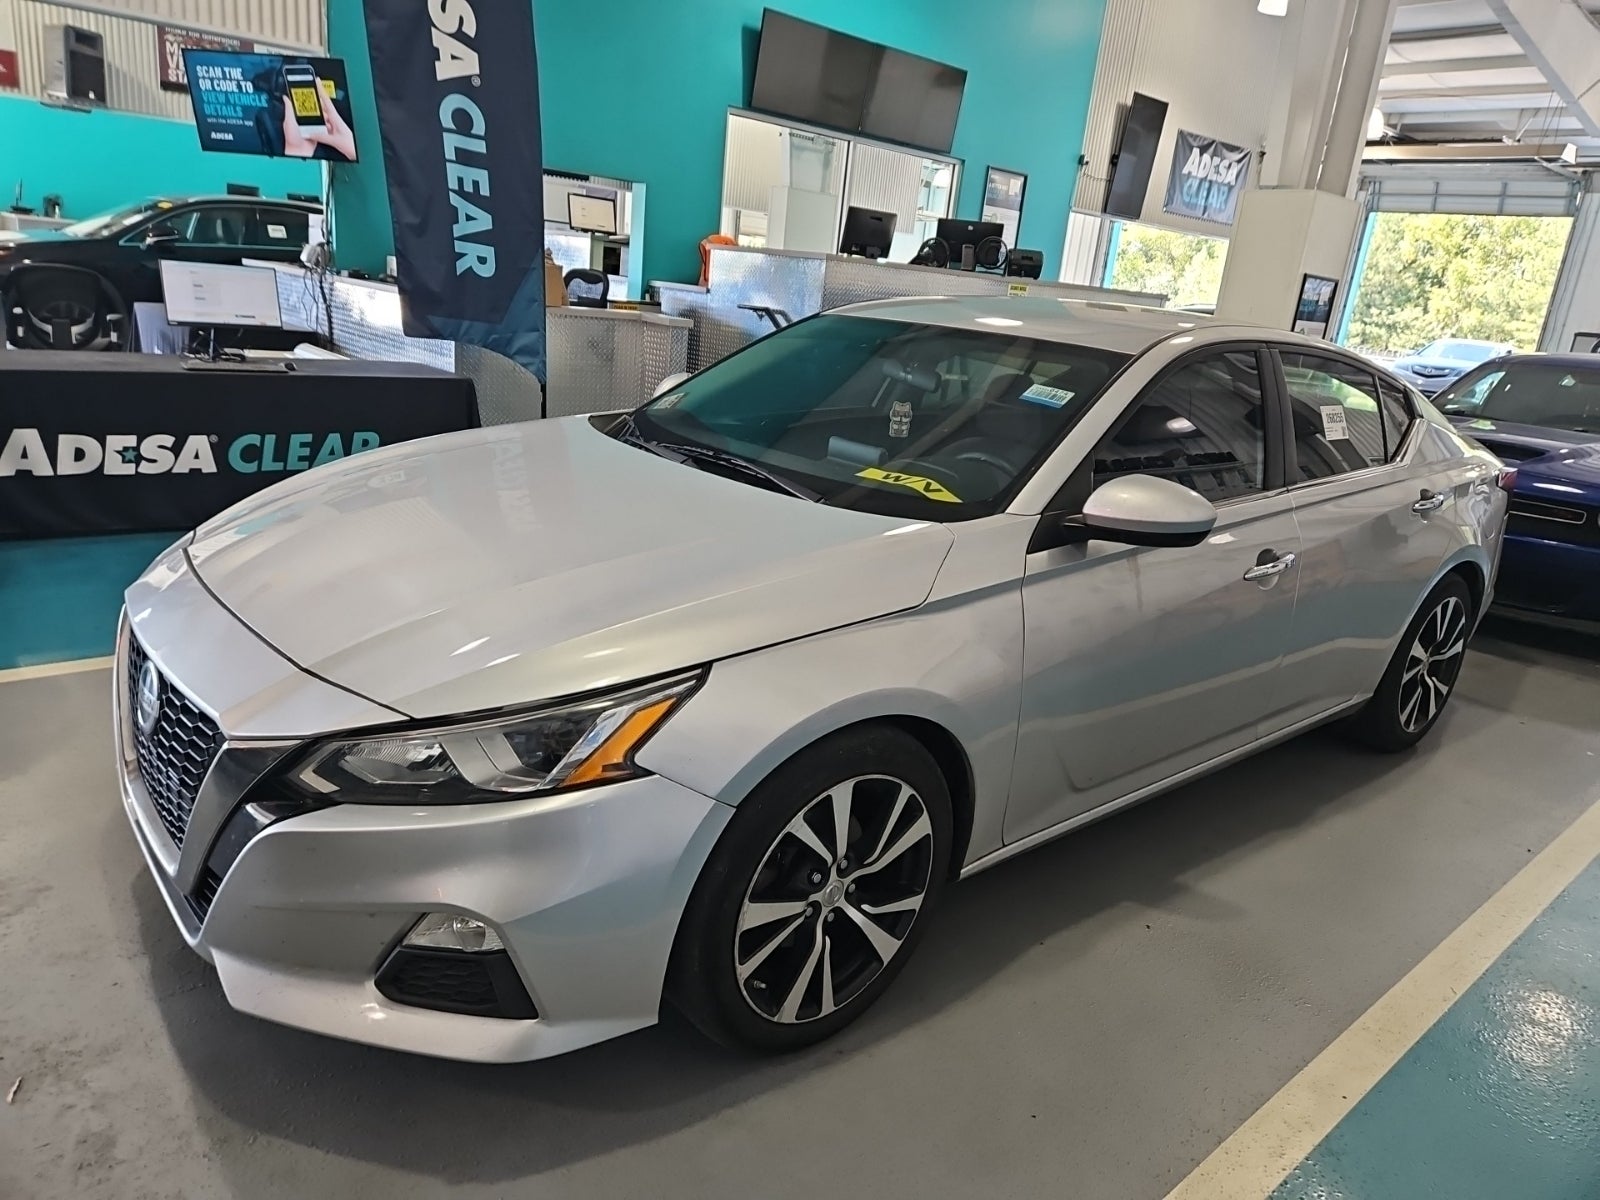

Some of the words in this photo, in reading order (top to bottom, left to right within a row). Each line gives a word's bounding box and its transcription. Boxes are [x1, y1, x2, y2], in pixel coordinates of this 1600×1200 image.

[196, 65, 223, 79] SCAN
[223, 66, 244, 80] THE
[213, 79, 239, 92] CODE
[240, 80, 253, 93] TO
[201, 90, 226, 103] VIEW
[228, 92, 269, 108] VEHICLE
[203, 103, 243, 118] DETAILS
[1182, 147, 1239, 186] ADESA
[439, 93, 496, 278] CLEAR
[1182, 178, 1229, 209] CLEAR
